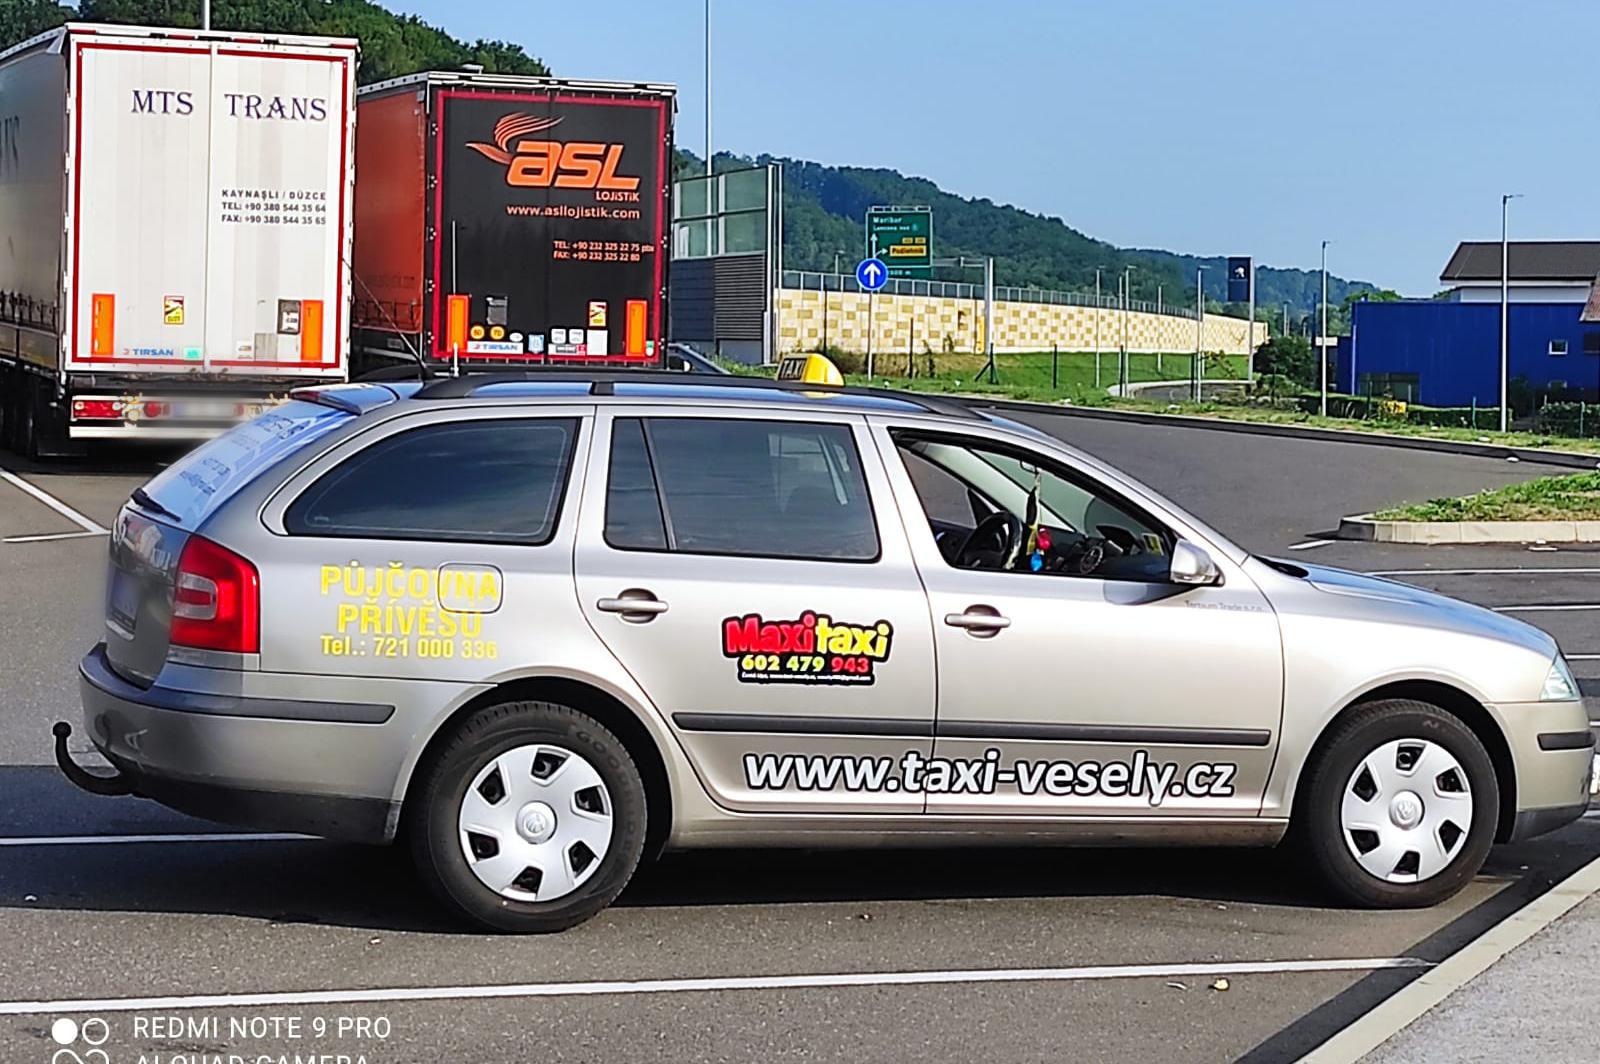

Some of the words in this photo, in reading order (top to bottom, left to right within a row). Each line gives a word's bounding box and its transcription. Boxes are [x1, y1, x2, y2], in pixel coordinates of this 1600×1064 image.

[131, 90, 194, 116] MTS
[224, 94, 327, 121] TRANS
[289, 190, 326, 200] DÜZCE
[222, 202, 242, 210] TEL:
[245, 202, 261, 211] +90
[263, 203, 280, 211] 380
[282, 203, 299, 212] 544
[301, 204, 313, 212] 35
[315, 204, 326, 212] 64
[221, 214, 242, 222] FAX:
[244, 215, 261, 223] +90
[263, 215, 280, 224] 380
[282, 216, 299, 224] 544
[301, 216, 313, 224] 35
[315, 216, 326, 225] 65
[133, 348, 174, 356] TIRSAN
[781, 360, 805, 379] TAXI
[320, 560, 498, 601] PŮJČOVNA
[320, 635, 366, 656] Tel.:
[373, 637, 409, 657] 721
[417, 639, 453, 659] 000
[461, 640, 497, 660] 336
[741, 655, 780, 671] 602
[786, 656, 825, 672] 479
[831, 657, 869, 673] 943
[743, 749, 1236, 807] www.taxi-vesely.cz
